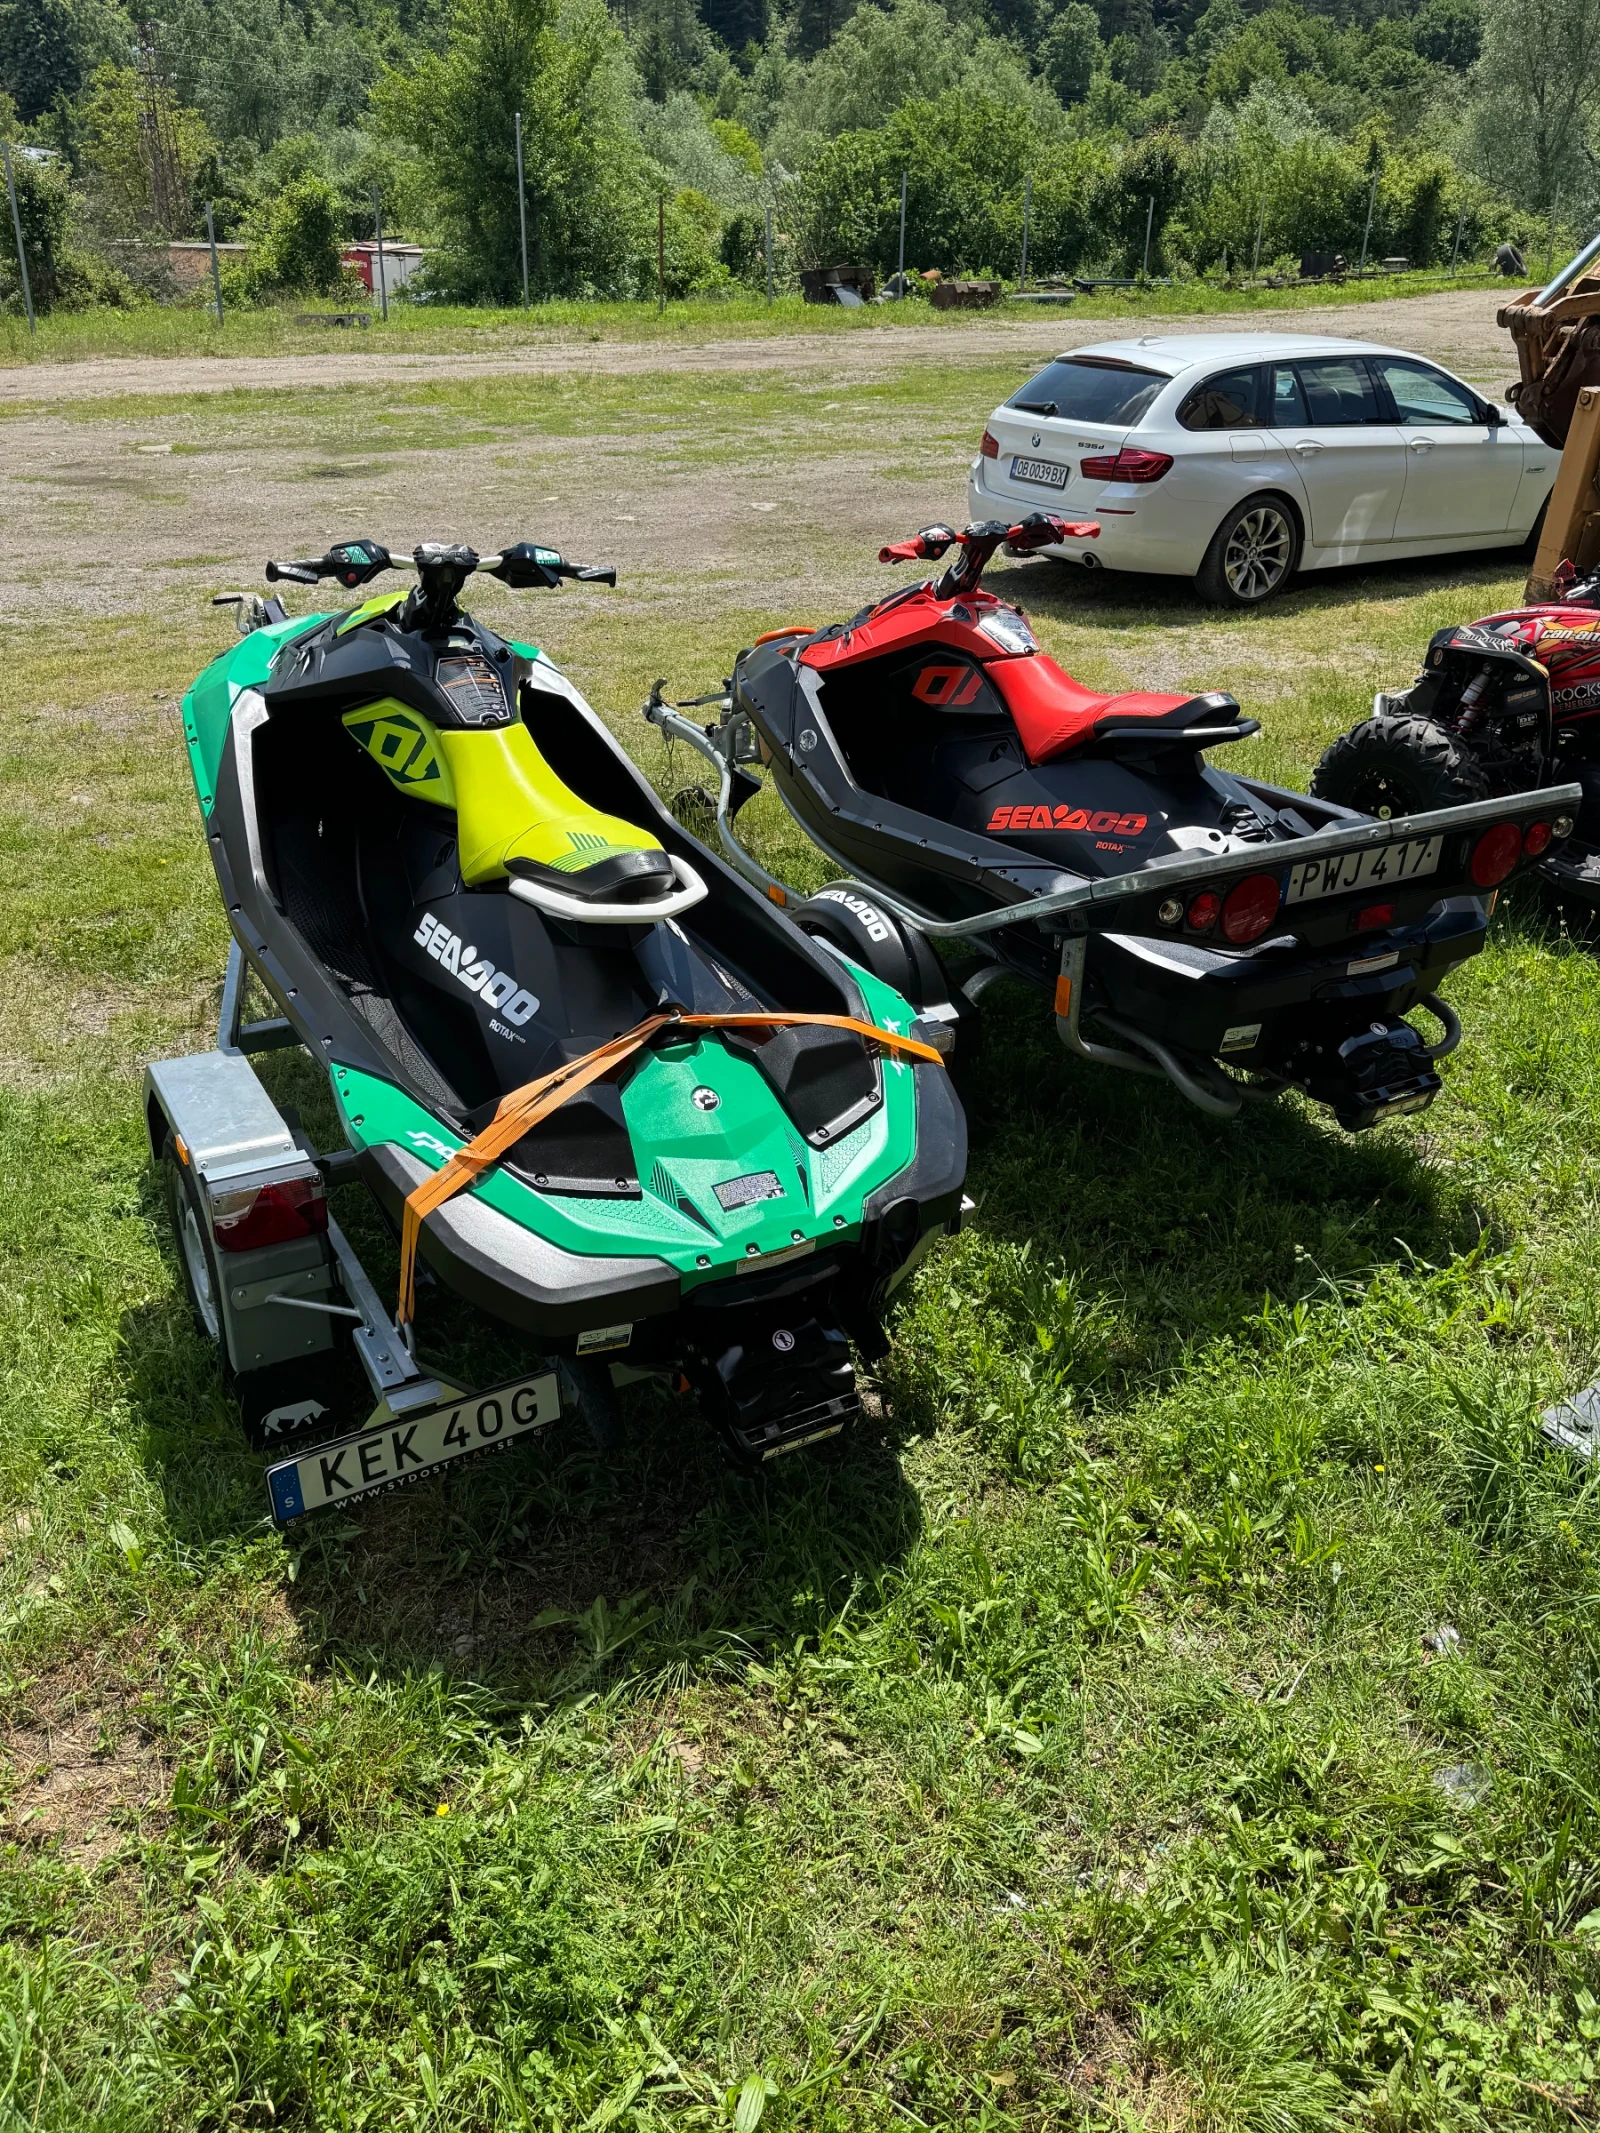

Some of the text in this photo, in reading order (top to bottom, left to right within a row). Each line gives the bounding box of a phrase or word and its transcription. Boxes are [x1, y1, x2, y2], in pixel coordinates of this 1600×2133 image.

[1017, 461, 1066, 483] OB 0039 BX
[1559, 697, 1597, 710] ENERGY
[1096, 841, 1123, 853] ROTAX
[1299, 838, 1432, 897] PWJ 417
[489, 1019, 516, 1042] ROTAX
[319, 1387, 539, 1497] KEK 40G
[334, 1438, 514, 1510] WWW.SYDOSTSLAP.SE
[284, 1496, 295, 1508] S
